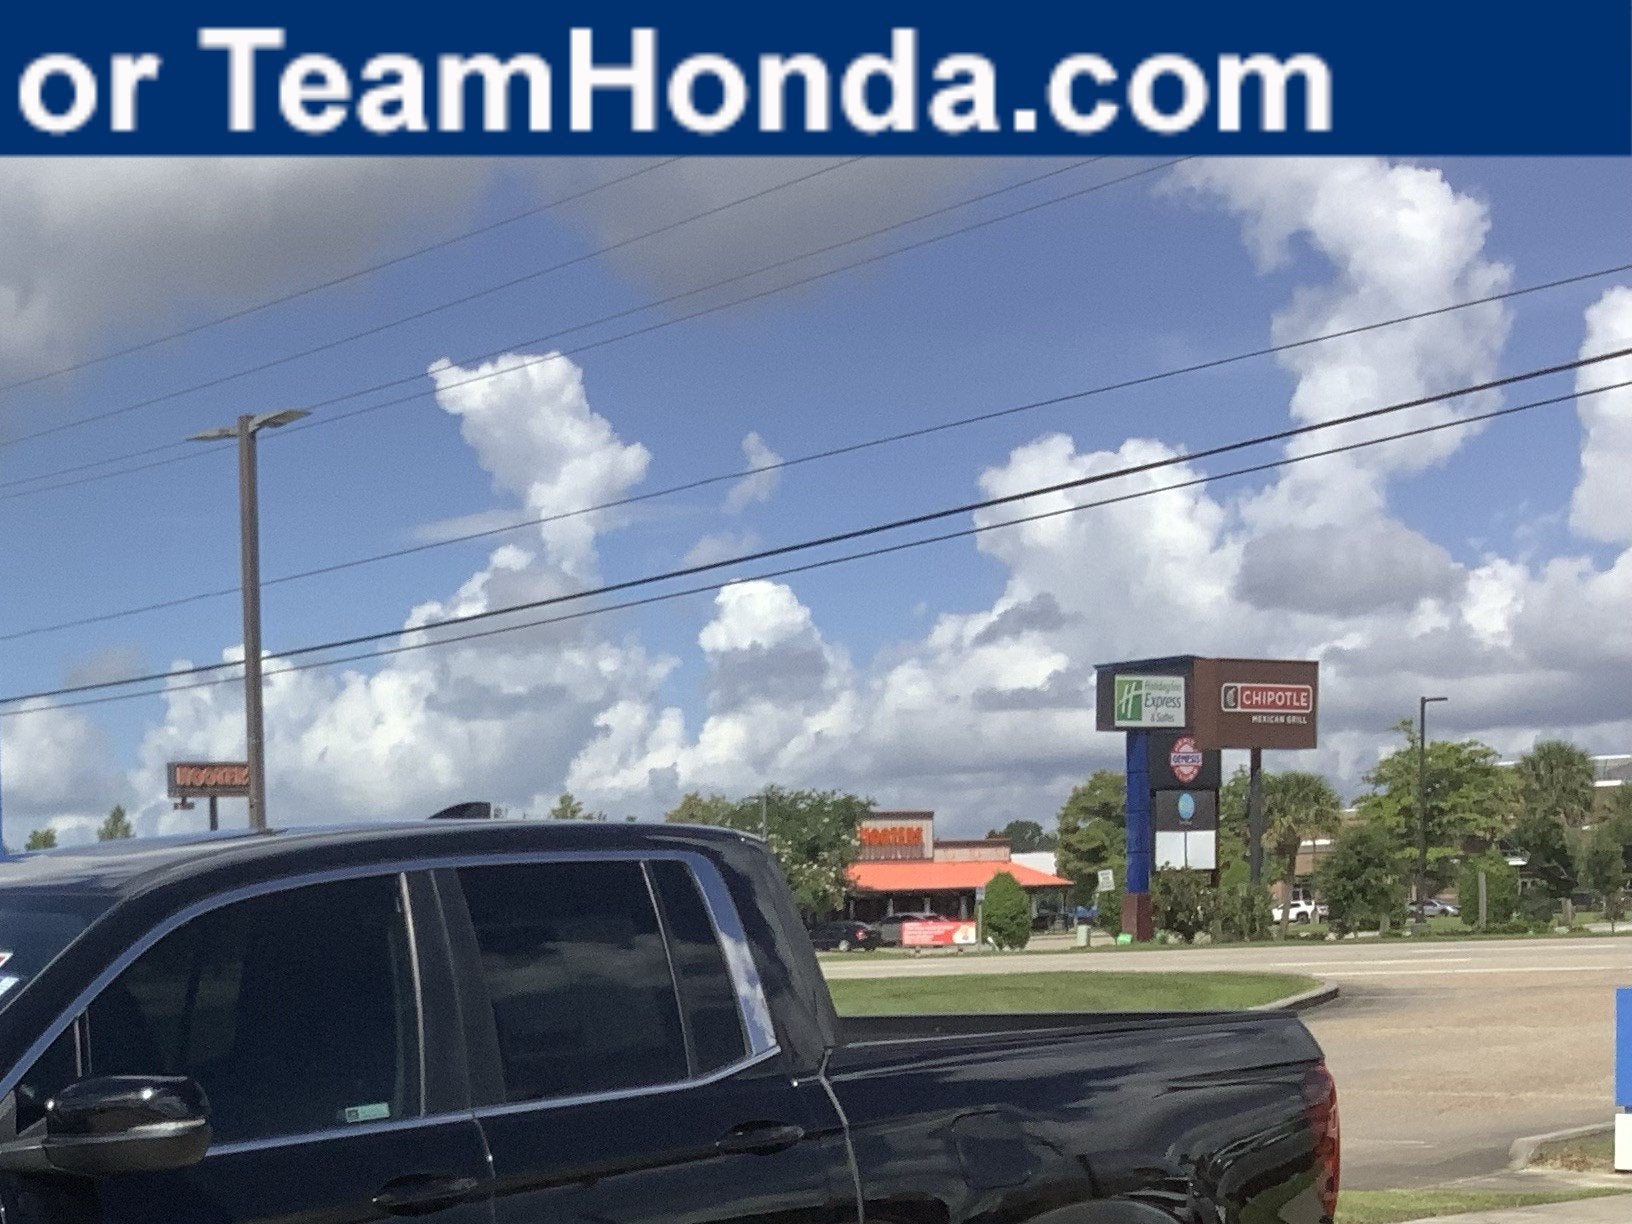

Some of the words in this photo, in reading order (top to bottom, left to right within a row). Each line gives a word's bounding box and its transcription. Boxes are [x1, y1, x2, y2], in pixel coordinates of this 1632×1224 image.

[1144, 692, 1182, 709] Express
[1242, 690, 1308, 706] CHIPOTLE
[1251, 715, 1285, 724] MEXICAN
[1286, 716, 1308, 724] GRILL
